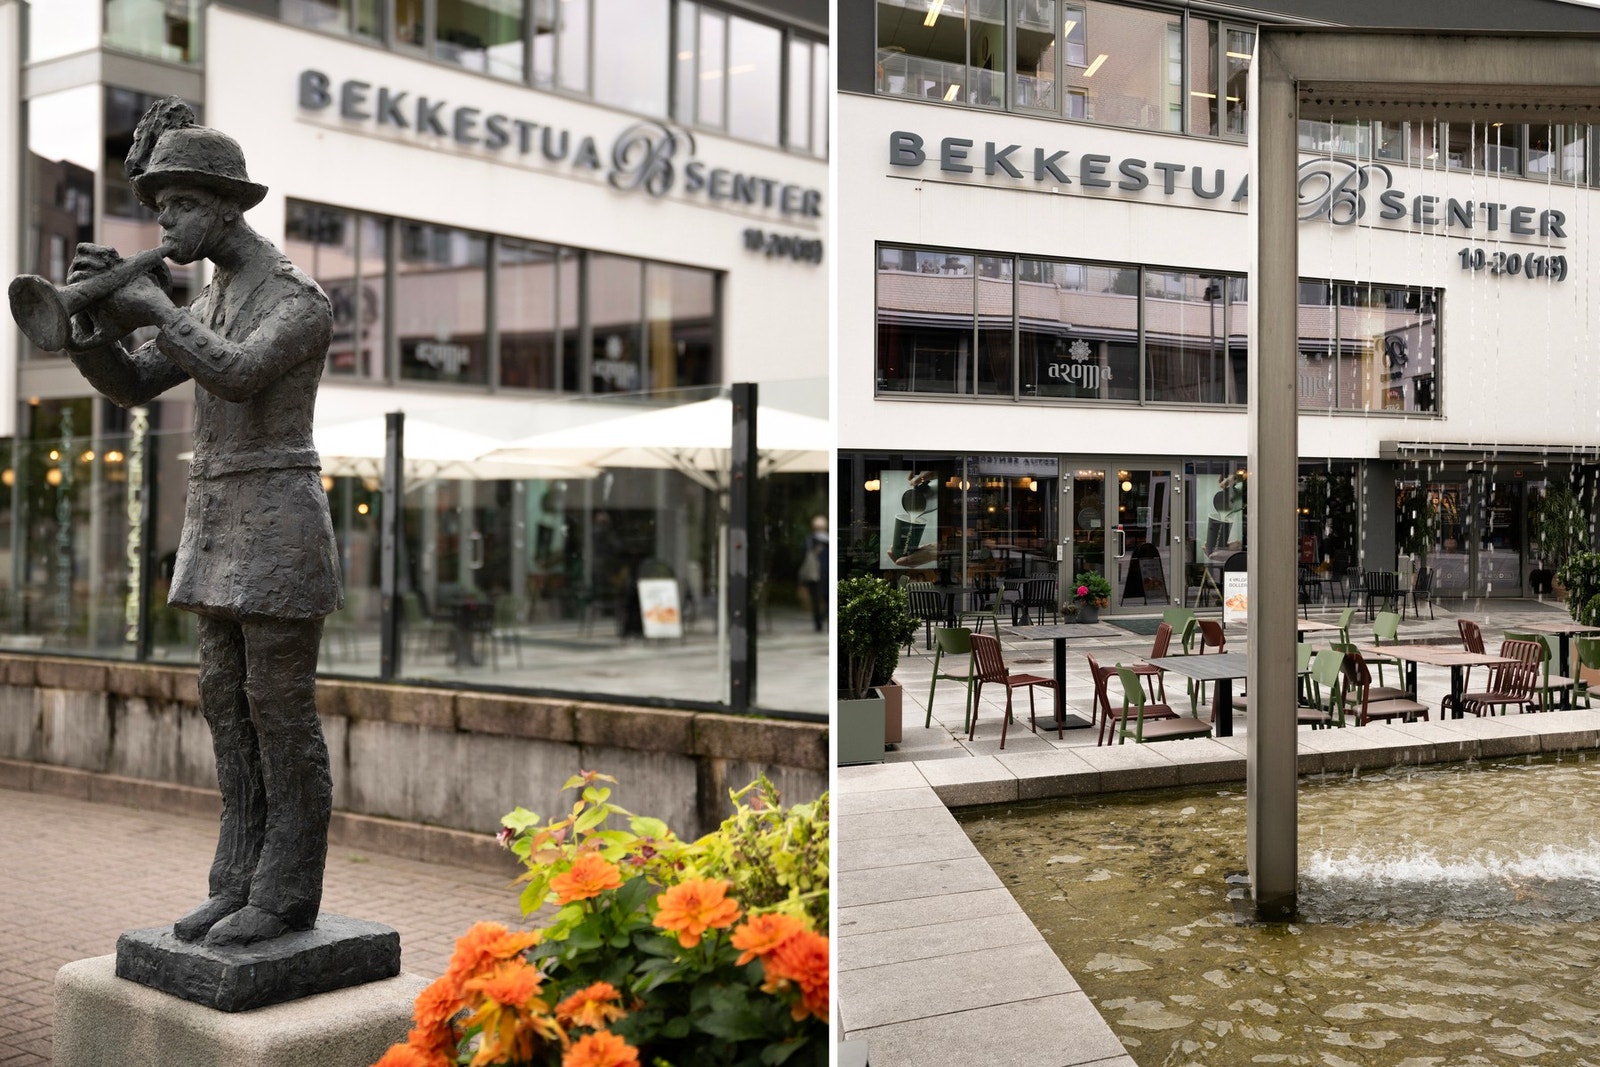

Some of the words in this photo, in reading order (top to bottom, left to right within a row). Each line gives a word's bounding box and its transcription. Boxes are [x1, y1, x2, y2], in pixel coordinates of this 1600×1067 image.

[298, 69, 602, 171] BEKKESTUA
[685, 161, 822, 218] SENTER
[1379, 189, 1568, 239] SENTER
[1048, 362, 1113, 390] aroma
